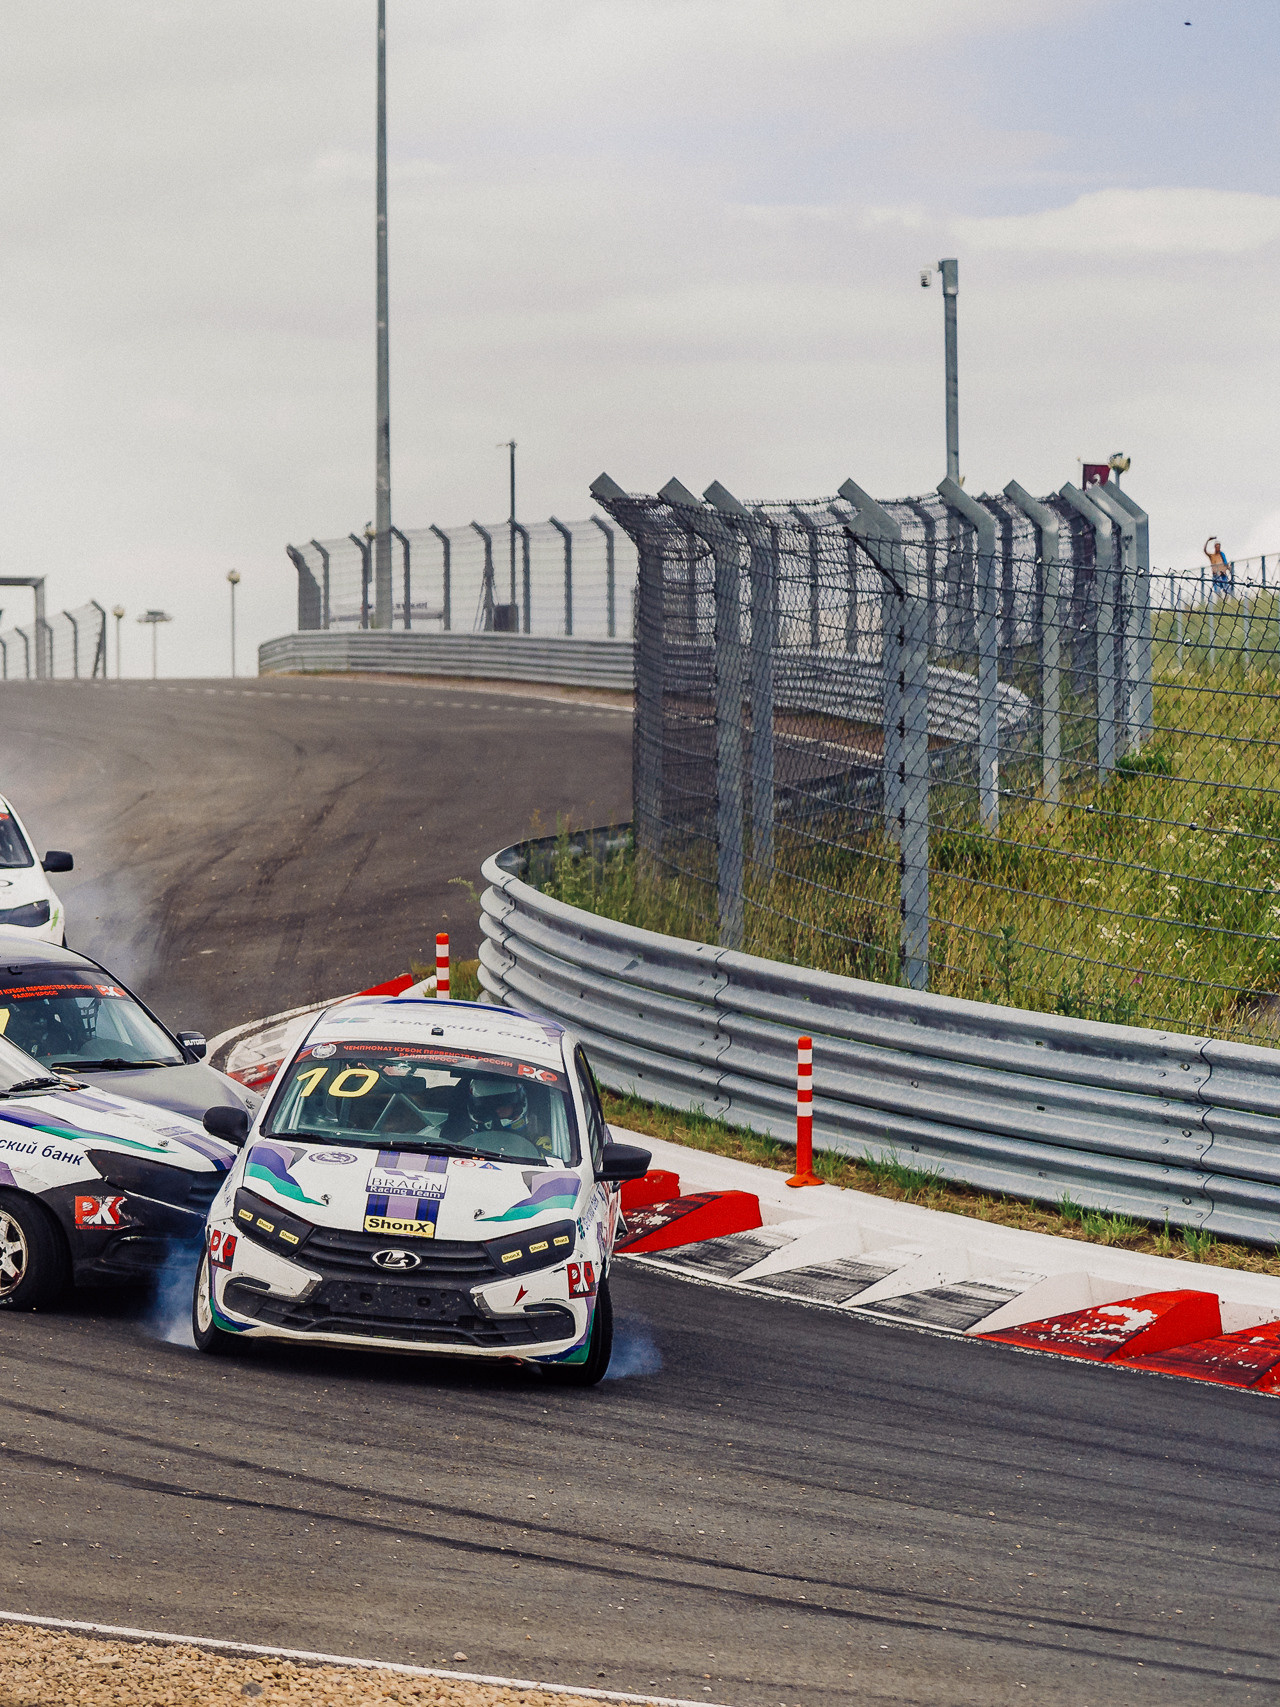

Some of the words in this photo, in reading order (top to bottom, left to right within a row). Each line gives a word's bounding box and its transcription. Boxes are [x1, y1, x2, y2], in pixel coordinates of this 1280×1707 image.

[394, 1047, 422, 1055] КУБОК
[423, 1048, 476, 1060] ПЕРВЕНСТВО
[477, 1055, 513, 1067] РОССИИ
[296, 1067, 380, 1098] 10
[41, 1144, 85, 1166] банк
[370, 1186, 407, 1196] Racing
[412, 1189, 442, 1199] Team
[368, 1217, 430, 1233] ShonX
